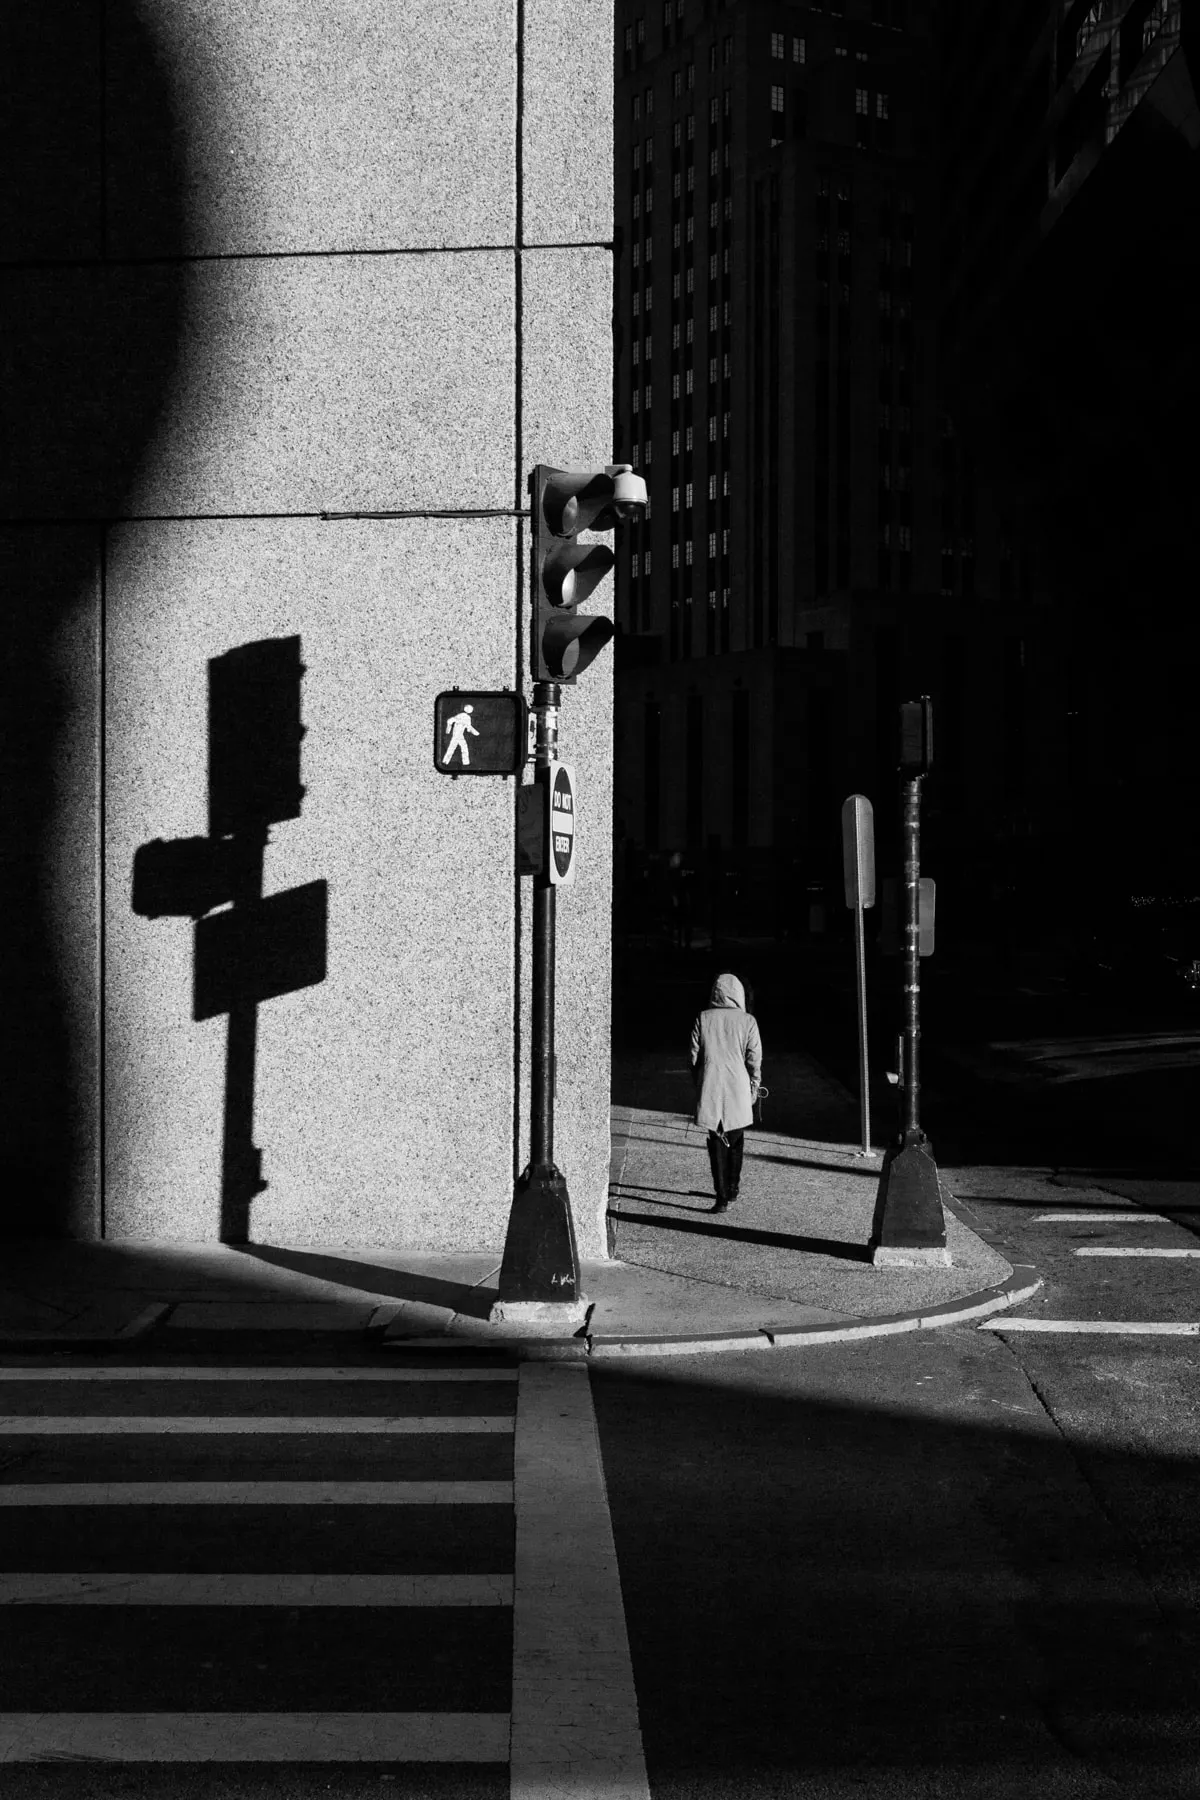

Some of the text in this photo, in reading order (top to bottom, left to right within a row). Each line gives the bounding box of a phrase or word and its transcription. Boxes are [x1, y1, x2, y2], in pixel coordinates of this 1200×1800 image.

[554, 790, 572, 810] DO NOT
[555, 836, 570, 853] ENTER
